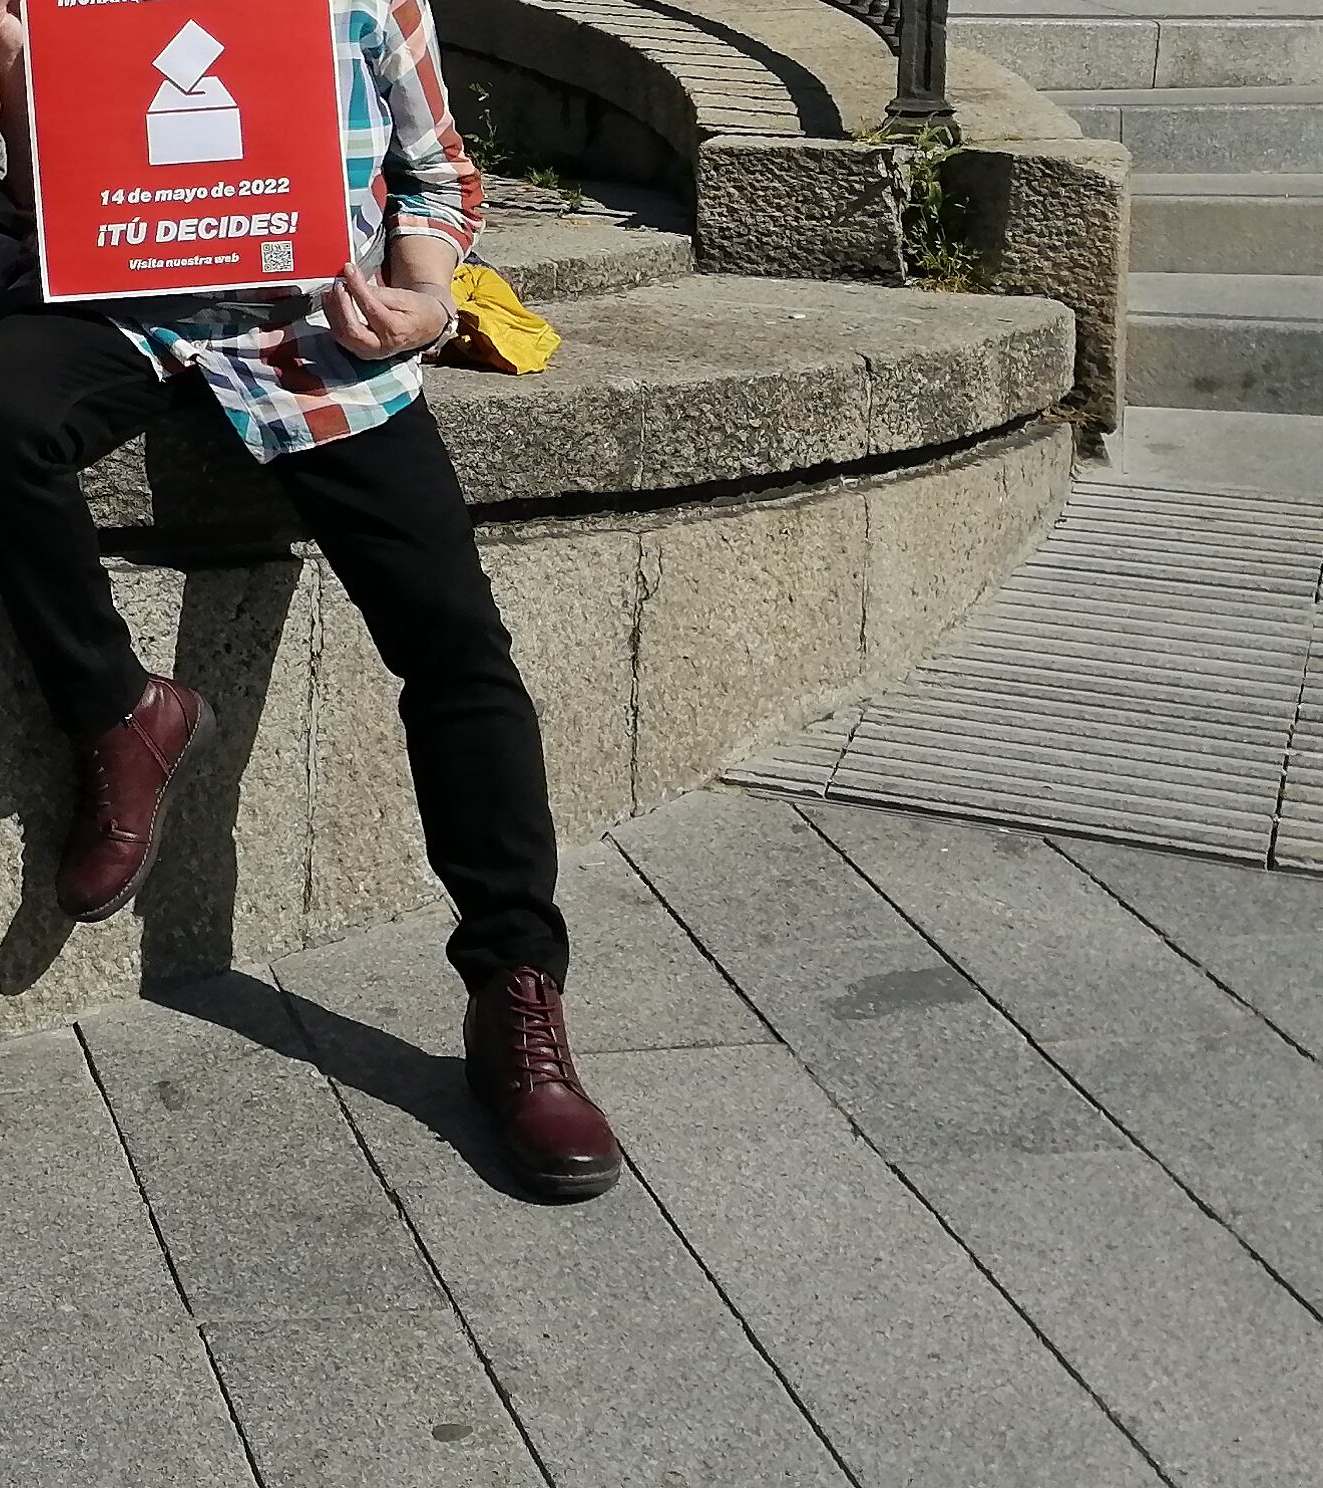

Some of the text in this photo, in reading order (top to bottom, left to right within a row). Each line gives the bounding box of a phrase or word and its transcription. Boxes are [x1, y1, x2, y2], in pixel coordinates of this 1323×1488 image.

[101, 178, 289, 205] 14 de mayo de 2022
[98, 212, 298, 246] ¡TÚ DECIDES!
